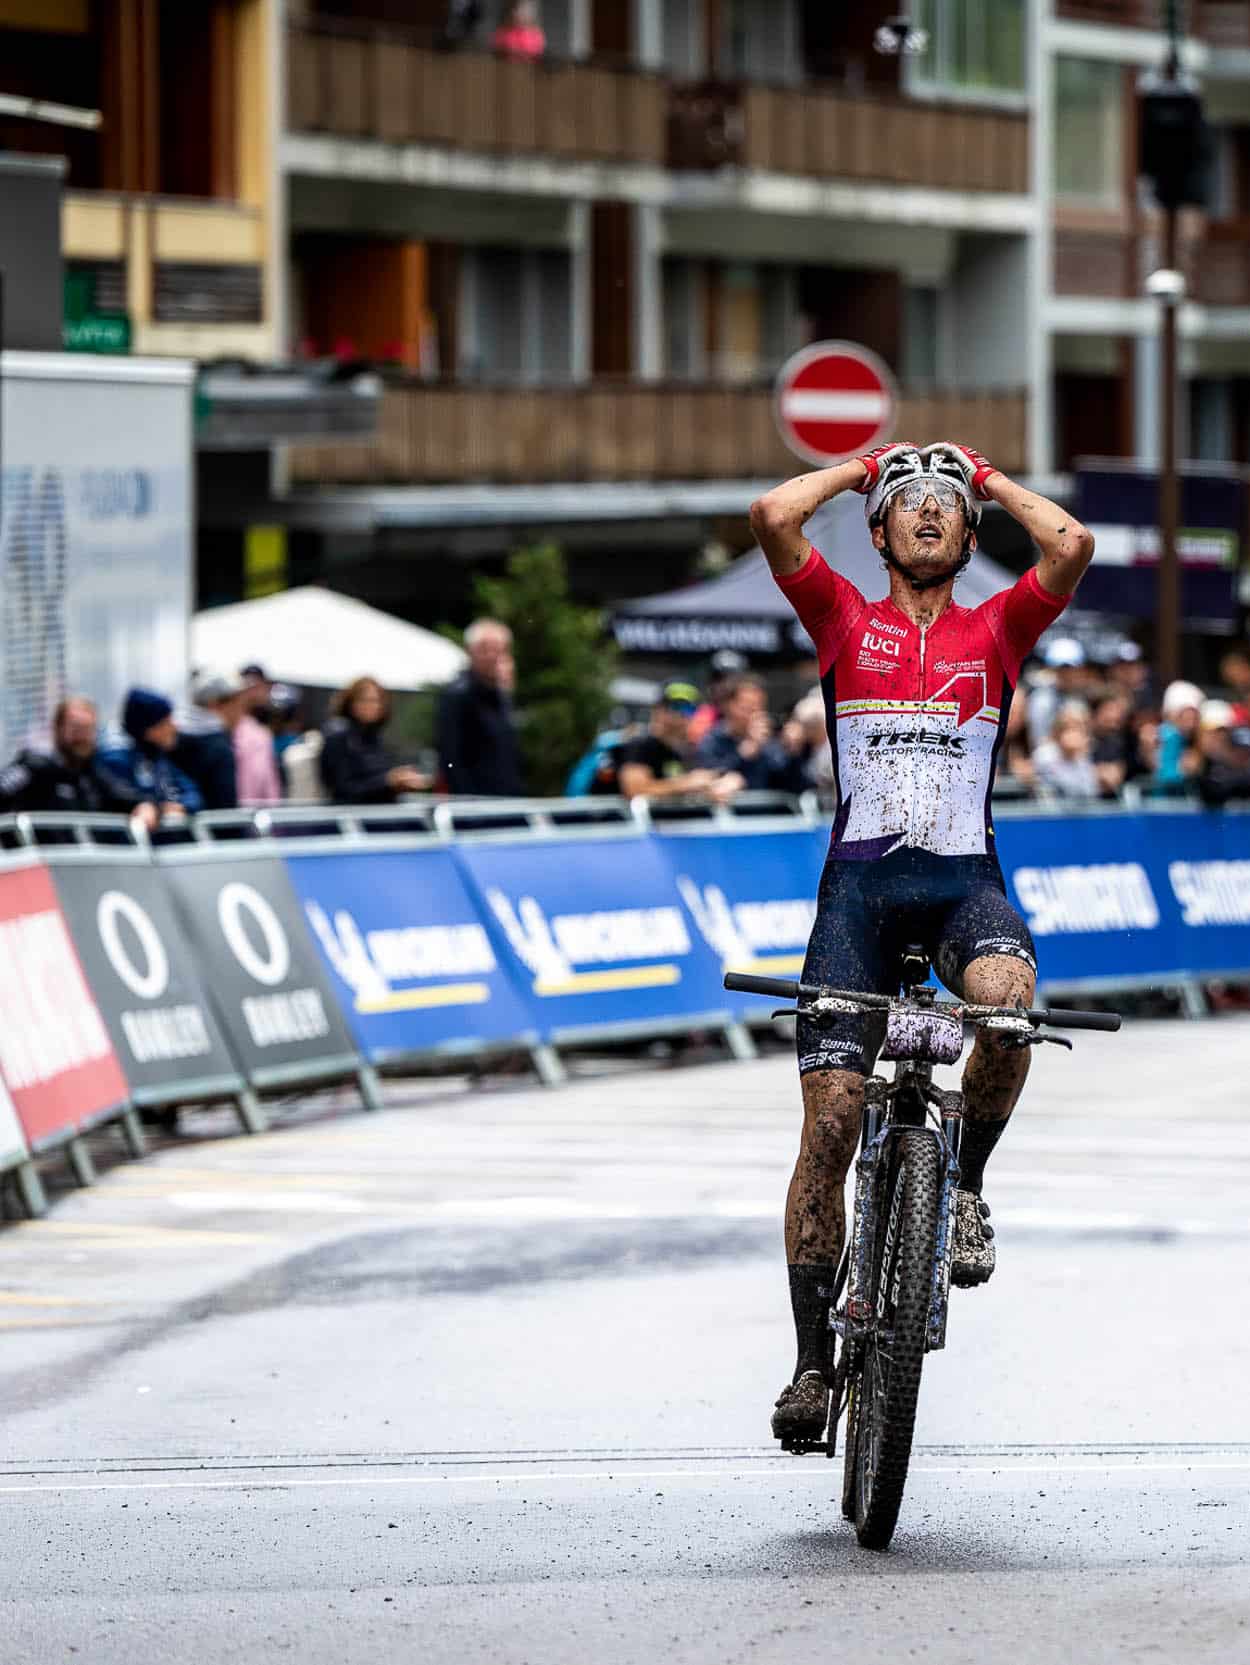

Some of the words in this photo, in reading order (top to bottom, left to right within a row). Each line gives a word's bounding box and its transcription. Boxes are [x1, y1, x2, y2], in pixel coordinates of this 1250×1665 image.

[867, 633, 900, 657] UCI
[865, 730, 968, 750] TREK
[866, 747, 919, 758] FACTORY
[920, 746, 967, 760] RACING
